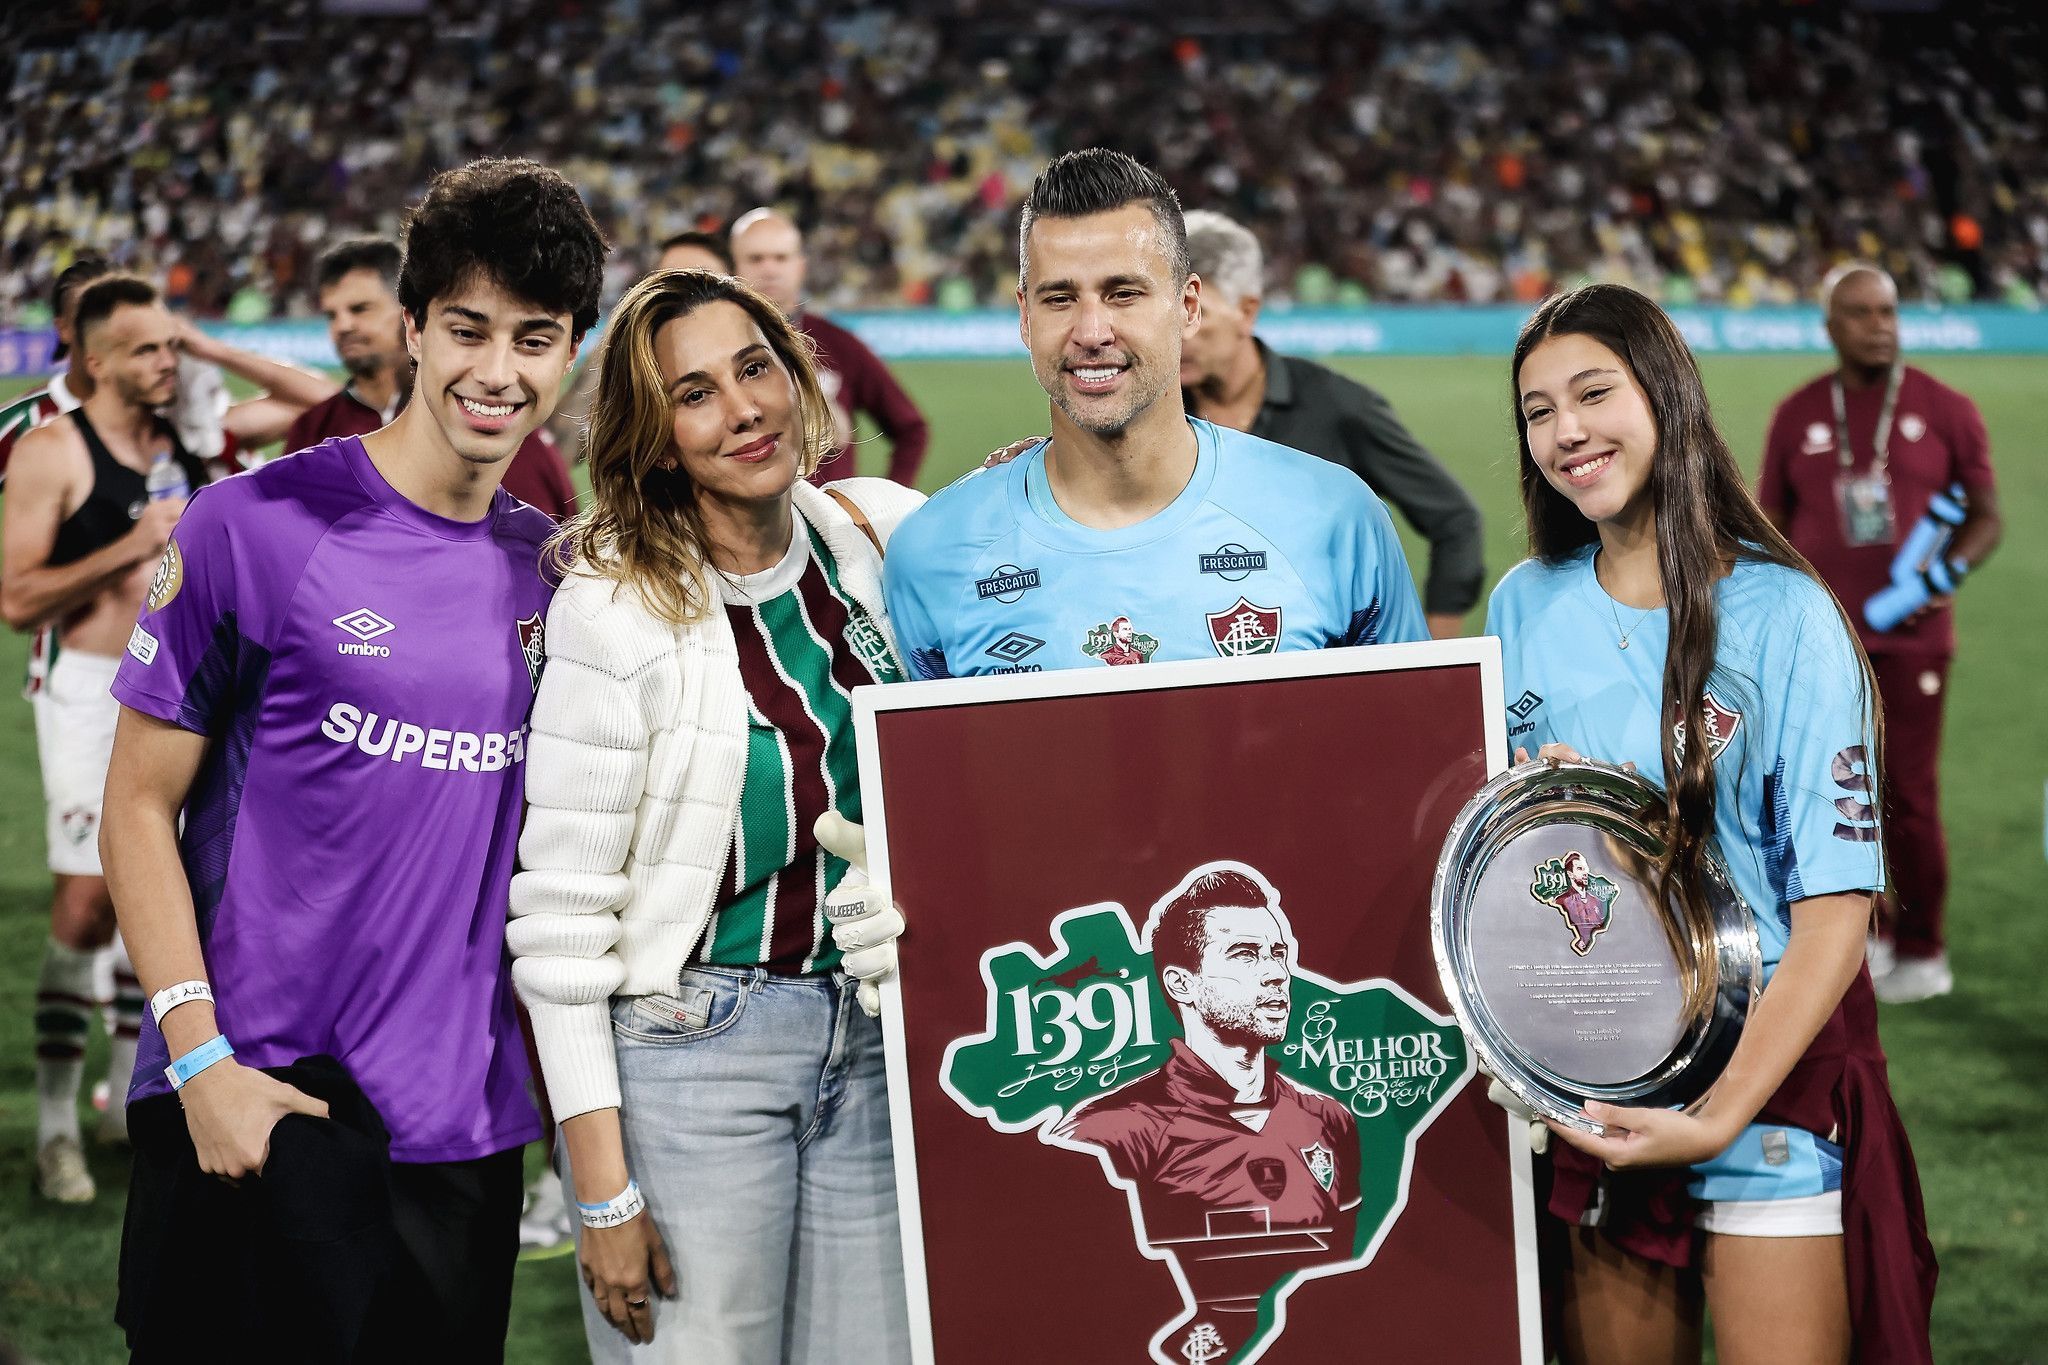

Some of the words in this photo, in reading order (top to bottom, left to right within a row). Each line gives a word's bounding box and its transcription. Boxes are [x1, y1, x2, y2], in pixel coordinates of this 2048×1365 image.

[1202, 555, 1263, 570] FRESCATTO
[978, 572, 1037, 597] FRESCATTO
[337, 641, 391, 658] umbro
[1508, 721, 1535, 737] umbro
[823, 901, 867, 918] OALKEEPER
[1299, 1032, 1458, 1069] MELHOR
[1329, 1058, 1448, 1091] GOLEIRO
[1351, 1076, 1440, 1118] Brasil
